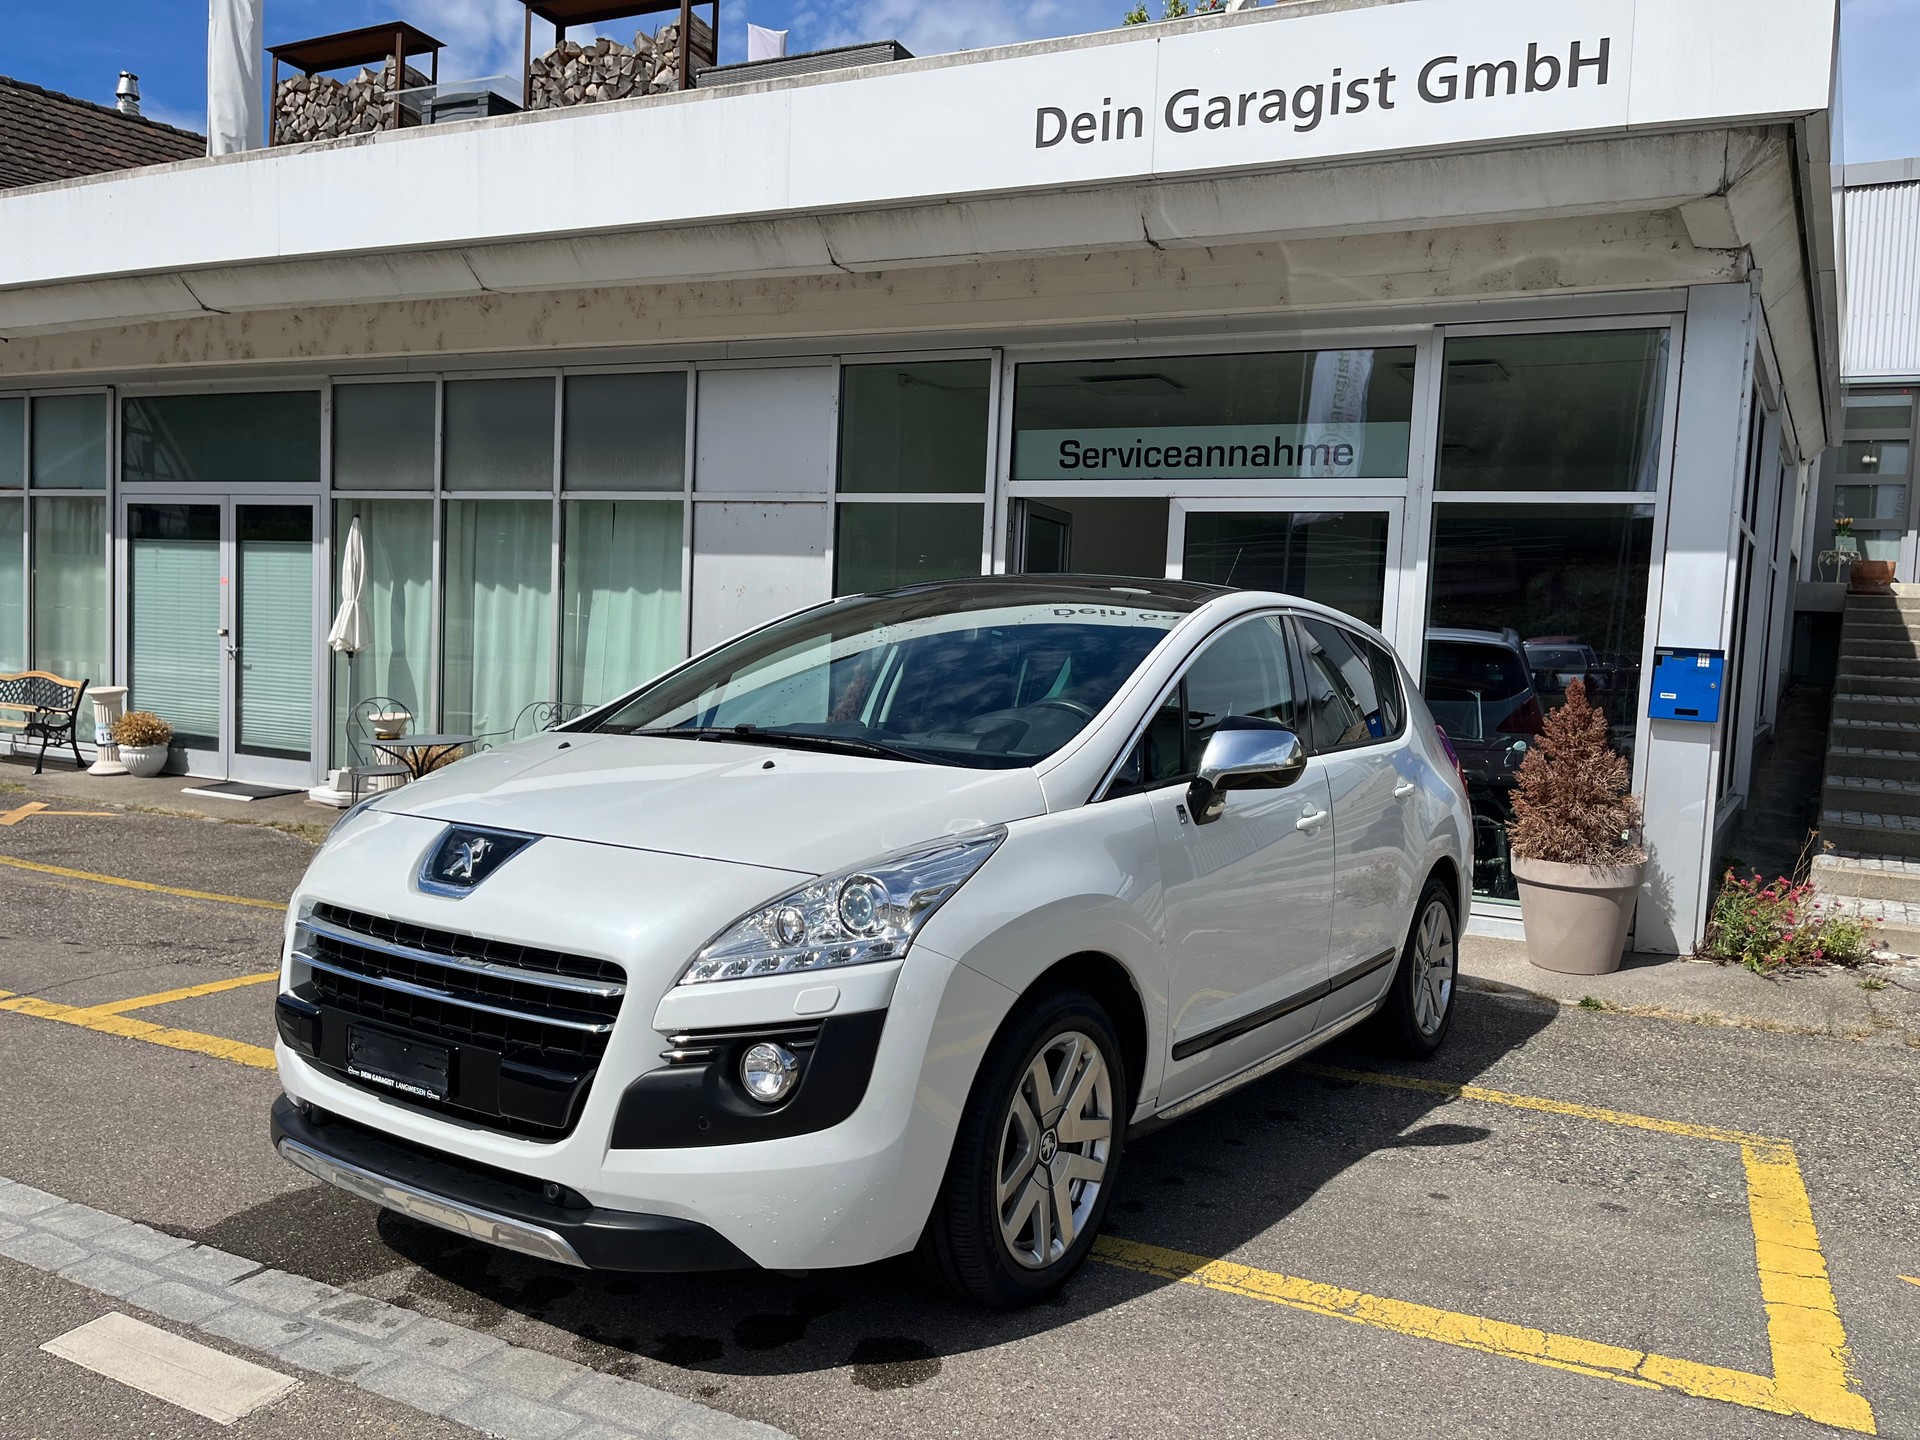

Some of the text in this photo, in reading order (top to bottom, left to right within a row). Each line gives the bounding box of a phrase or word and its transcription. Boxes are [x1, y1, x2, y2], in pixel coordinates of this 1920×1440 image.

[1035, 37, 1611, 148] Dein Garagist GmbH
[1059, 436, 1354, 469] Serviceannahme
[101, 732, 113, 742] 13
[360, 1070, 372, 1080] DEIN
[371, 1073, 395, 1087] GARAGIST
[395, 1081, 426, 1097] LANGWIESEN
